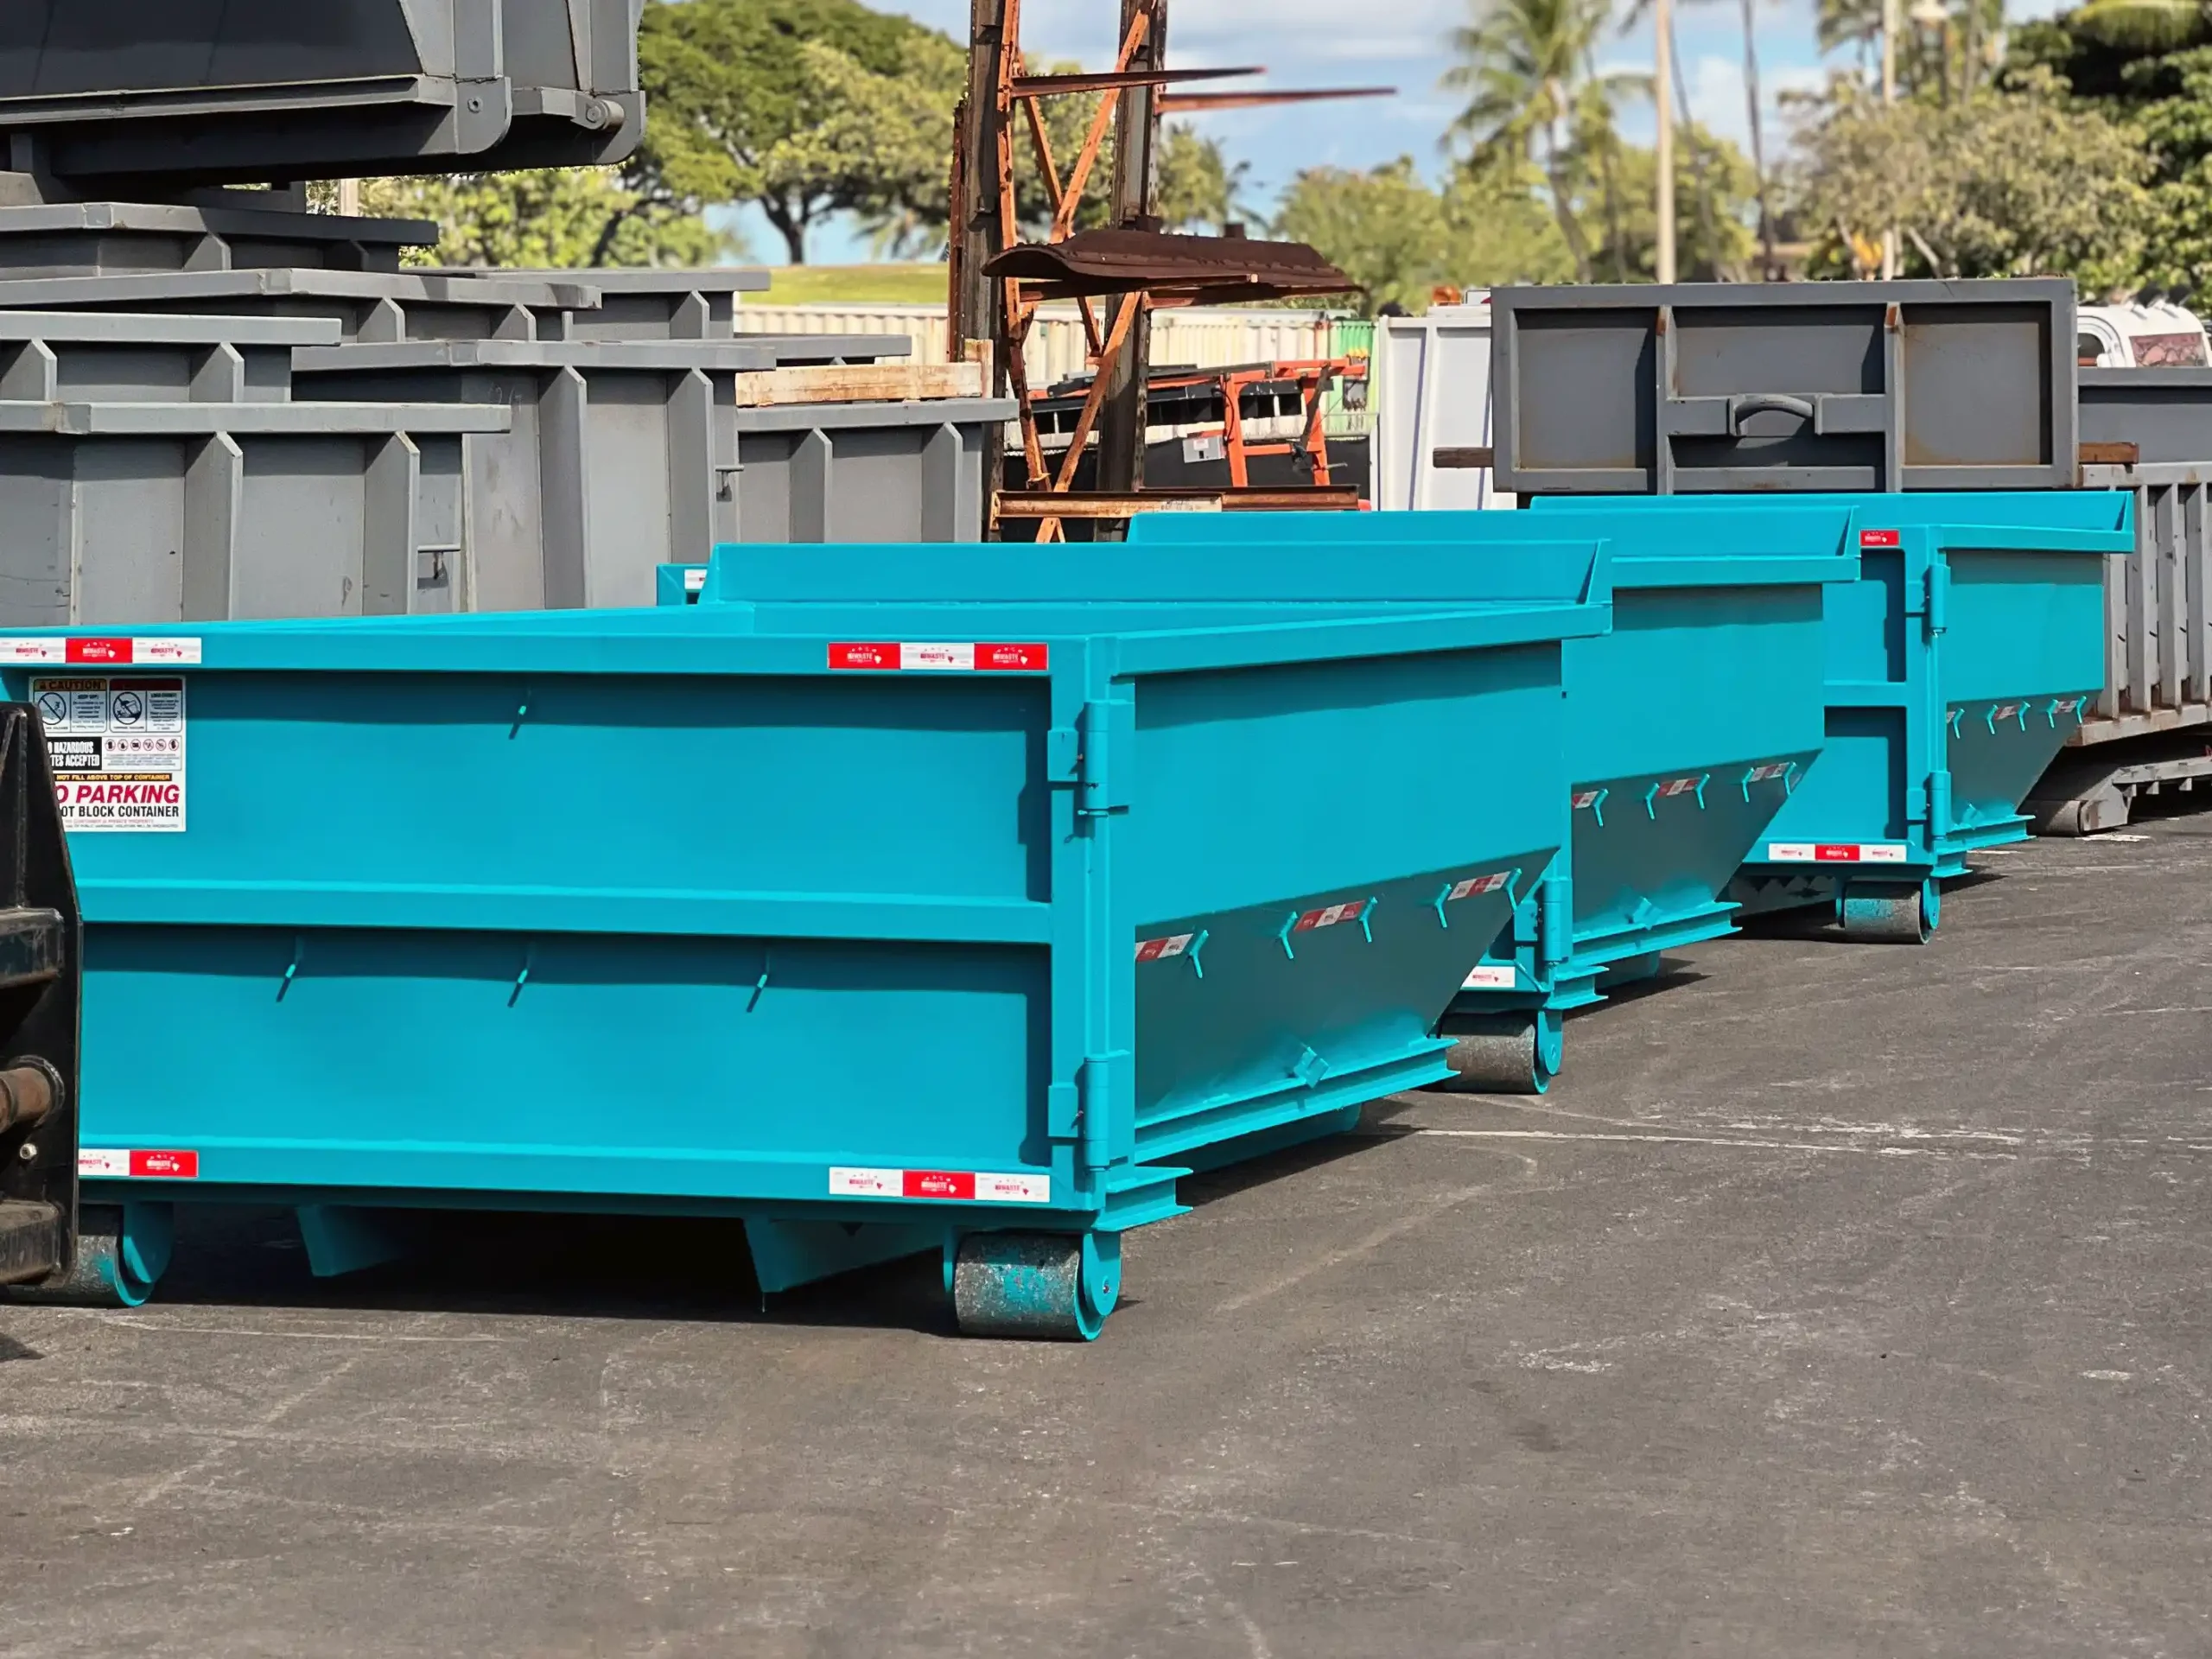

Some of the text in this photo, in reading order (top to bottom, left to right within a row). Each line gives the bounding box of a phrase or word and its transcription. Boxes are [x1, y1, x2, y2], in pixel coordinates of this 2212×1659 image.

[49, 679, 101, 690] CAUTION
[54, 741, 94, 753] HAZARDOUS
[65, 754, 100, 766] ACCEPTED
[55, 785, 180, 804] O PARKING
[61, 805, 180, 817] OT BLOCK CONTAINER
